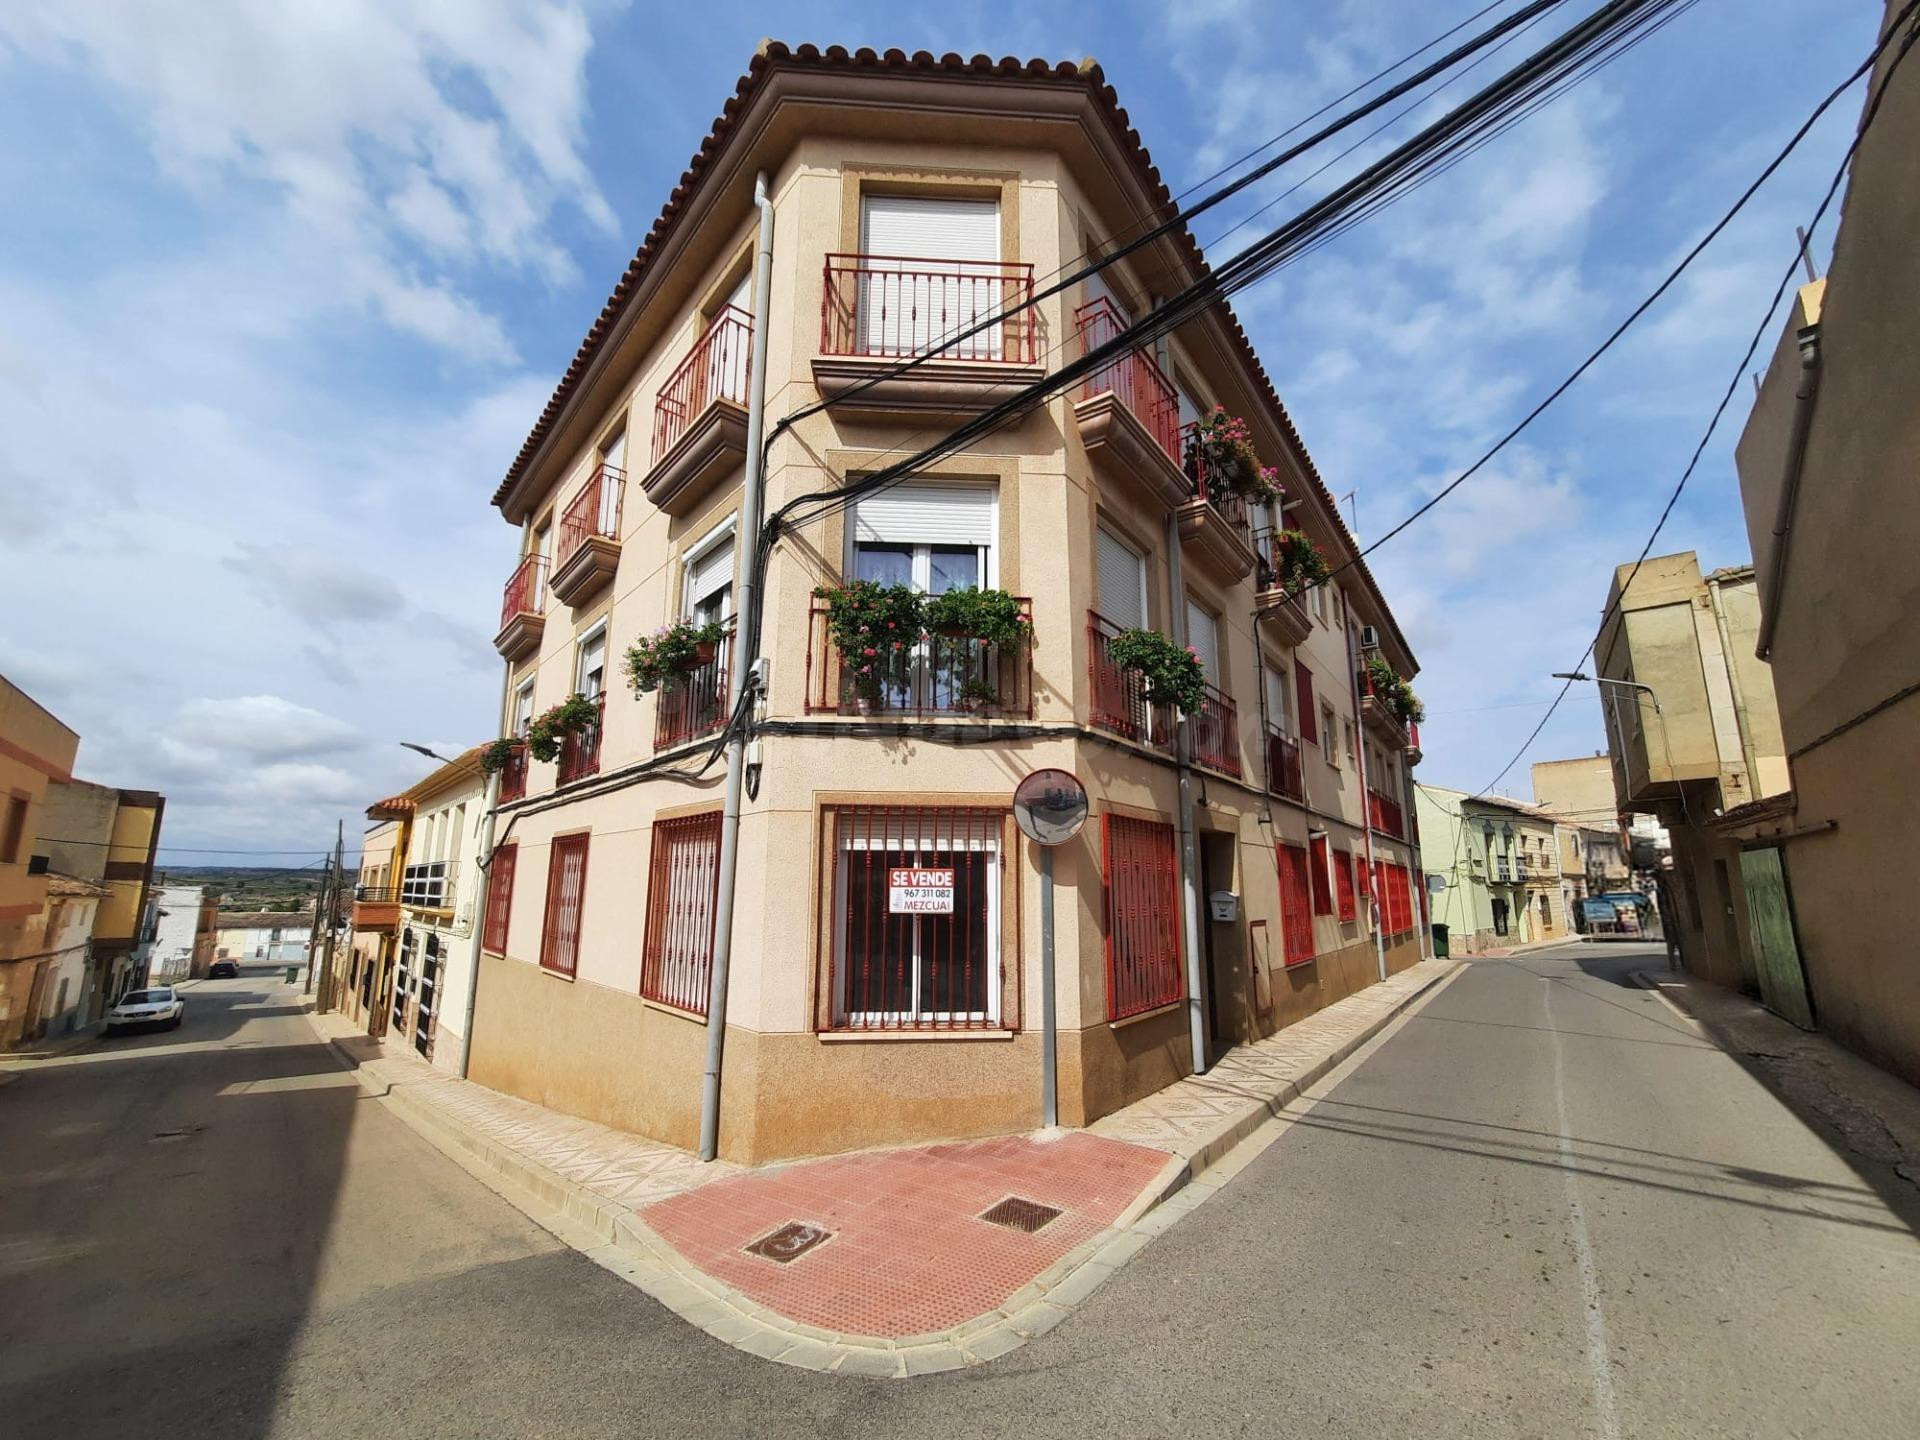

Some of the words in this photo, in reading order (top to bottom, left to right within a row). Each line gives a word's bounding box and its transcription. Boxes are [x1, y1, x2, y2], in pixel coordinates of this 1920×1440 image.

[892, 871, 908, 886] SE
[909, 871, 953, 886] VENDE
[904, 889, 920, 898] 967
[921, 889, 934, 898] 311
[935, 889, 951, 898] 082
[904, 901, 947, 911] MEZCUA
